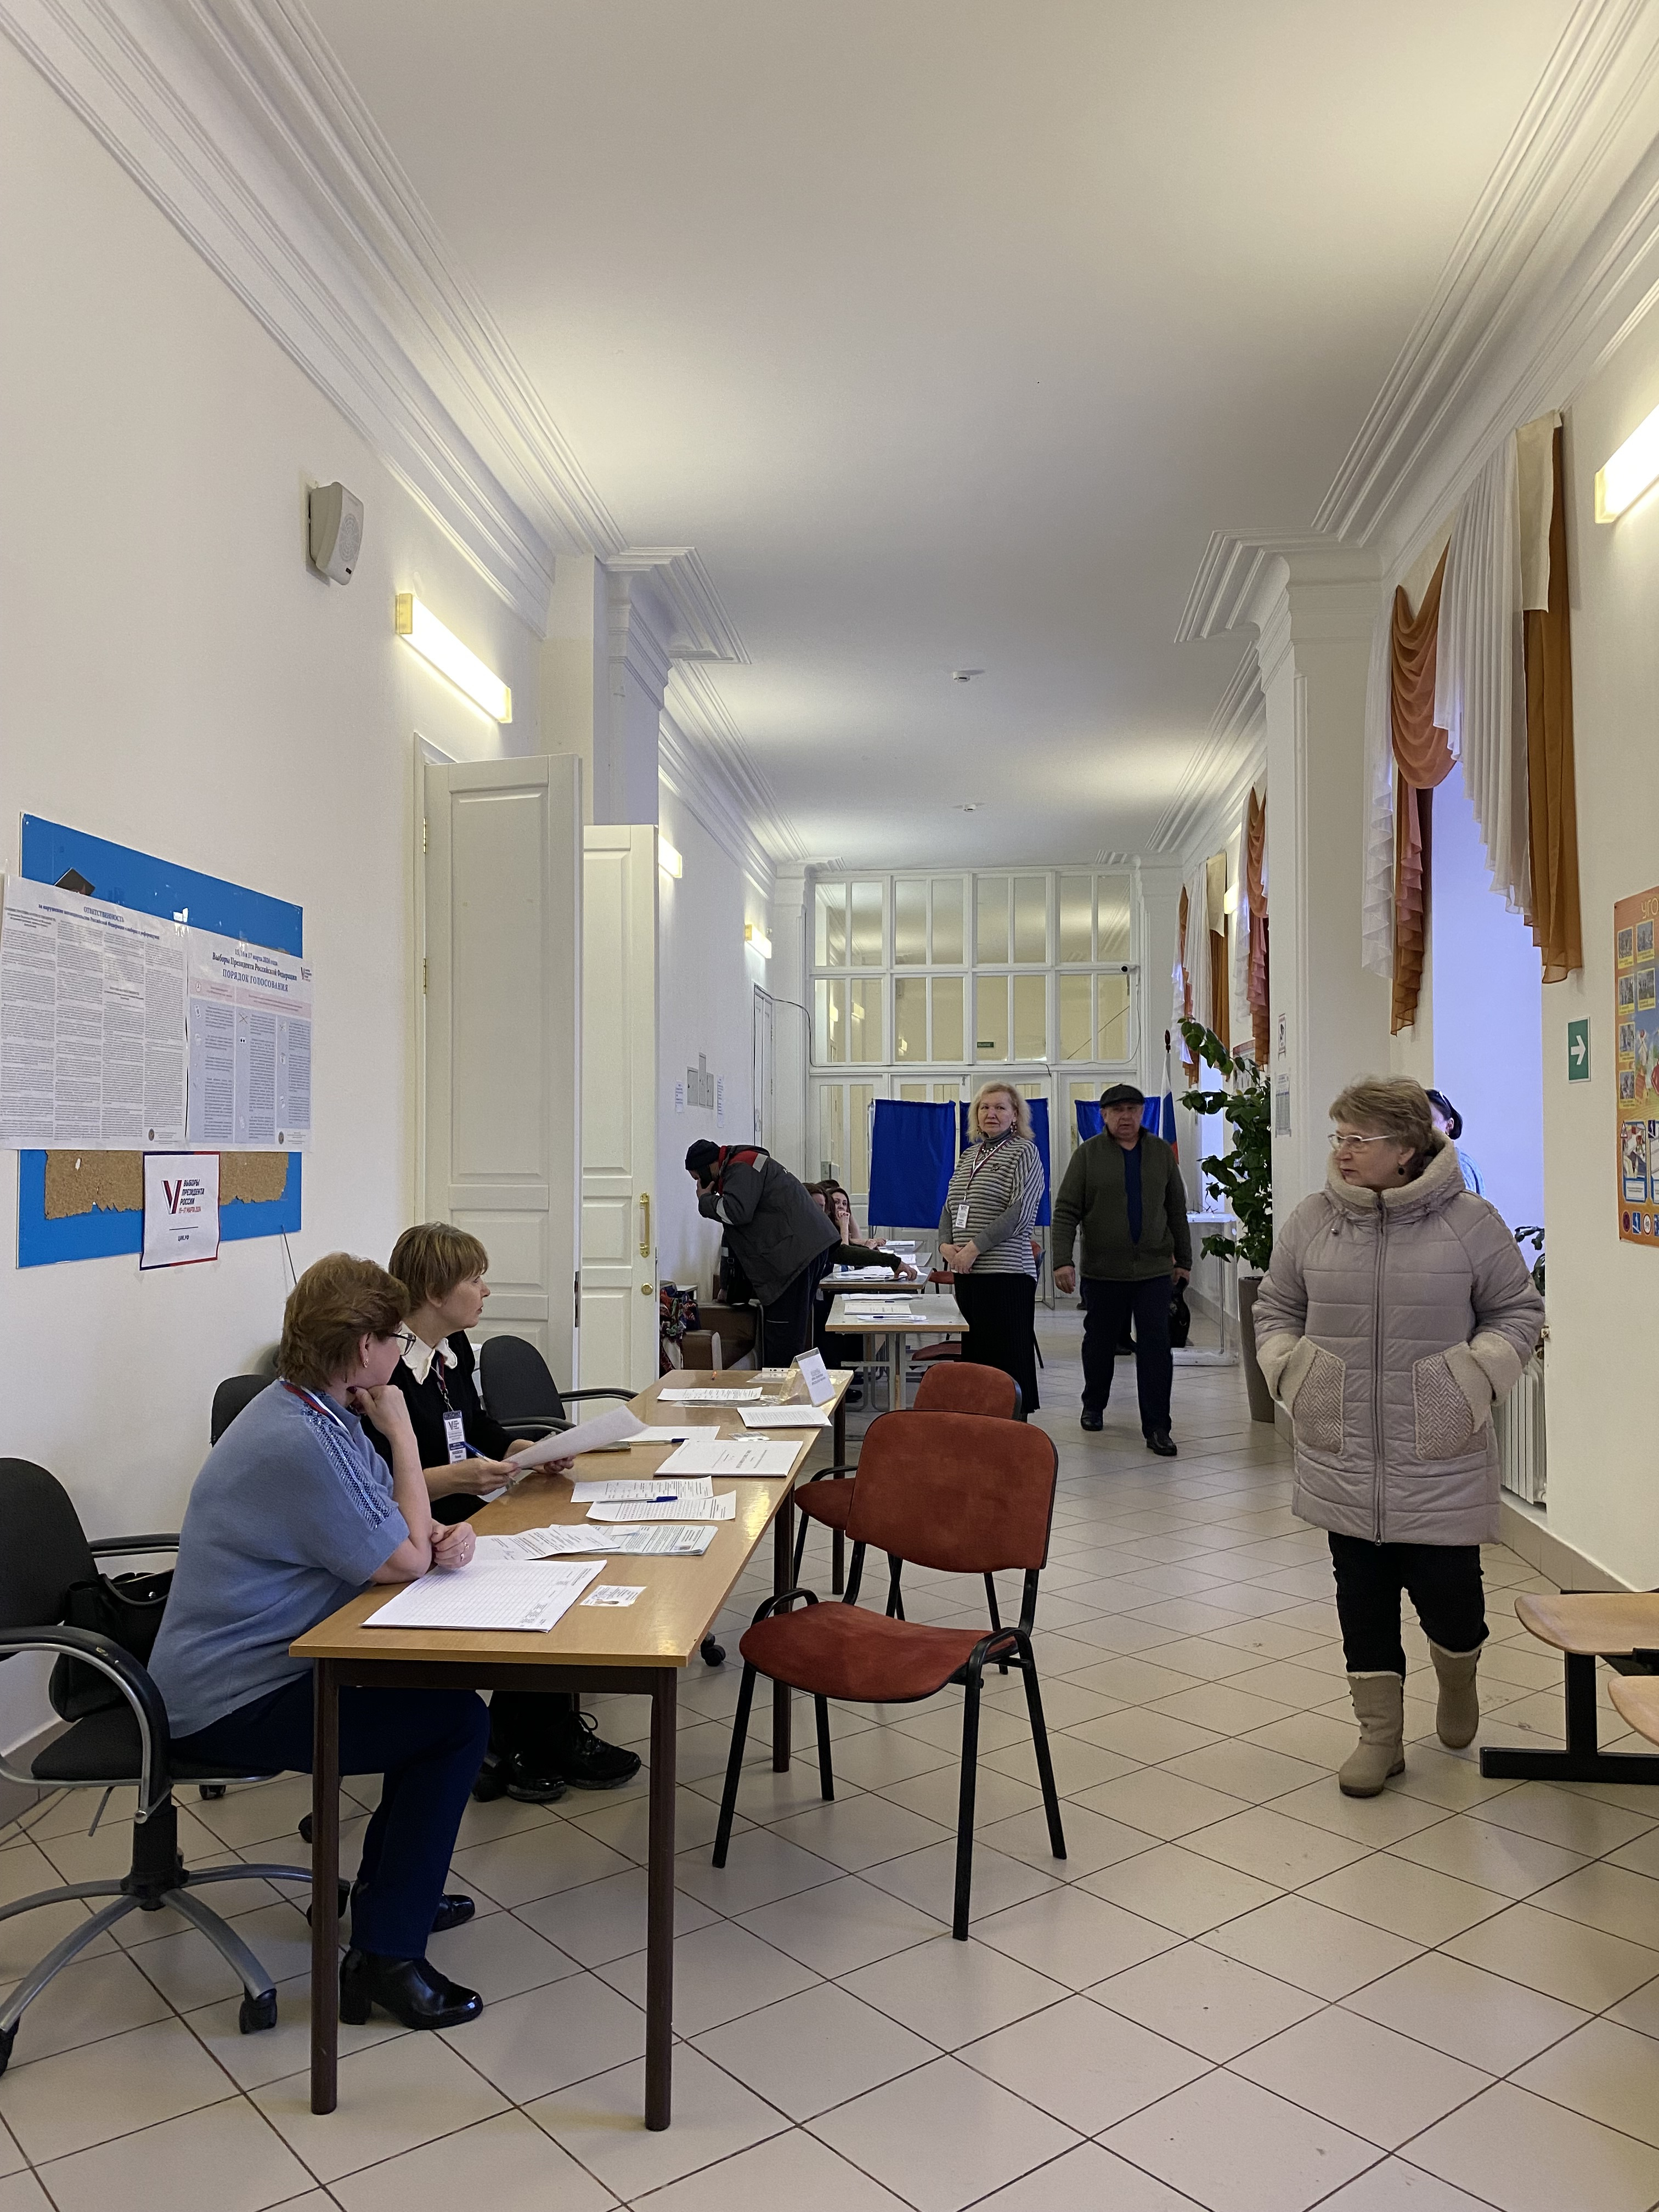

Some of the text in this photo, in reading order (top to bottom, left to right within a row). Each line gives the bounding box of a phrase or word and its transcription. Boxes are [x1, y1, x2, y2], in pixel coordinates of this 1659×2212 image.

[83, 906, 125, 922] ОТВЕТСТВЕННОСТЬ
[212, 952, 230, 964] Выборы
[230, 957, 254, 970] Президента
[255, 963, 277, 976] Российской
[223, 969, 249, 983] ПОРЯДОК
[250, 975, 288, 992] ГОЛОСОВАНИЯ
[182, 1188, 205, 1197] ПРЕЗИДЕНТА
[180, 1198, 195, 1206] РОССИИ
